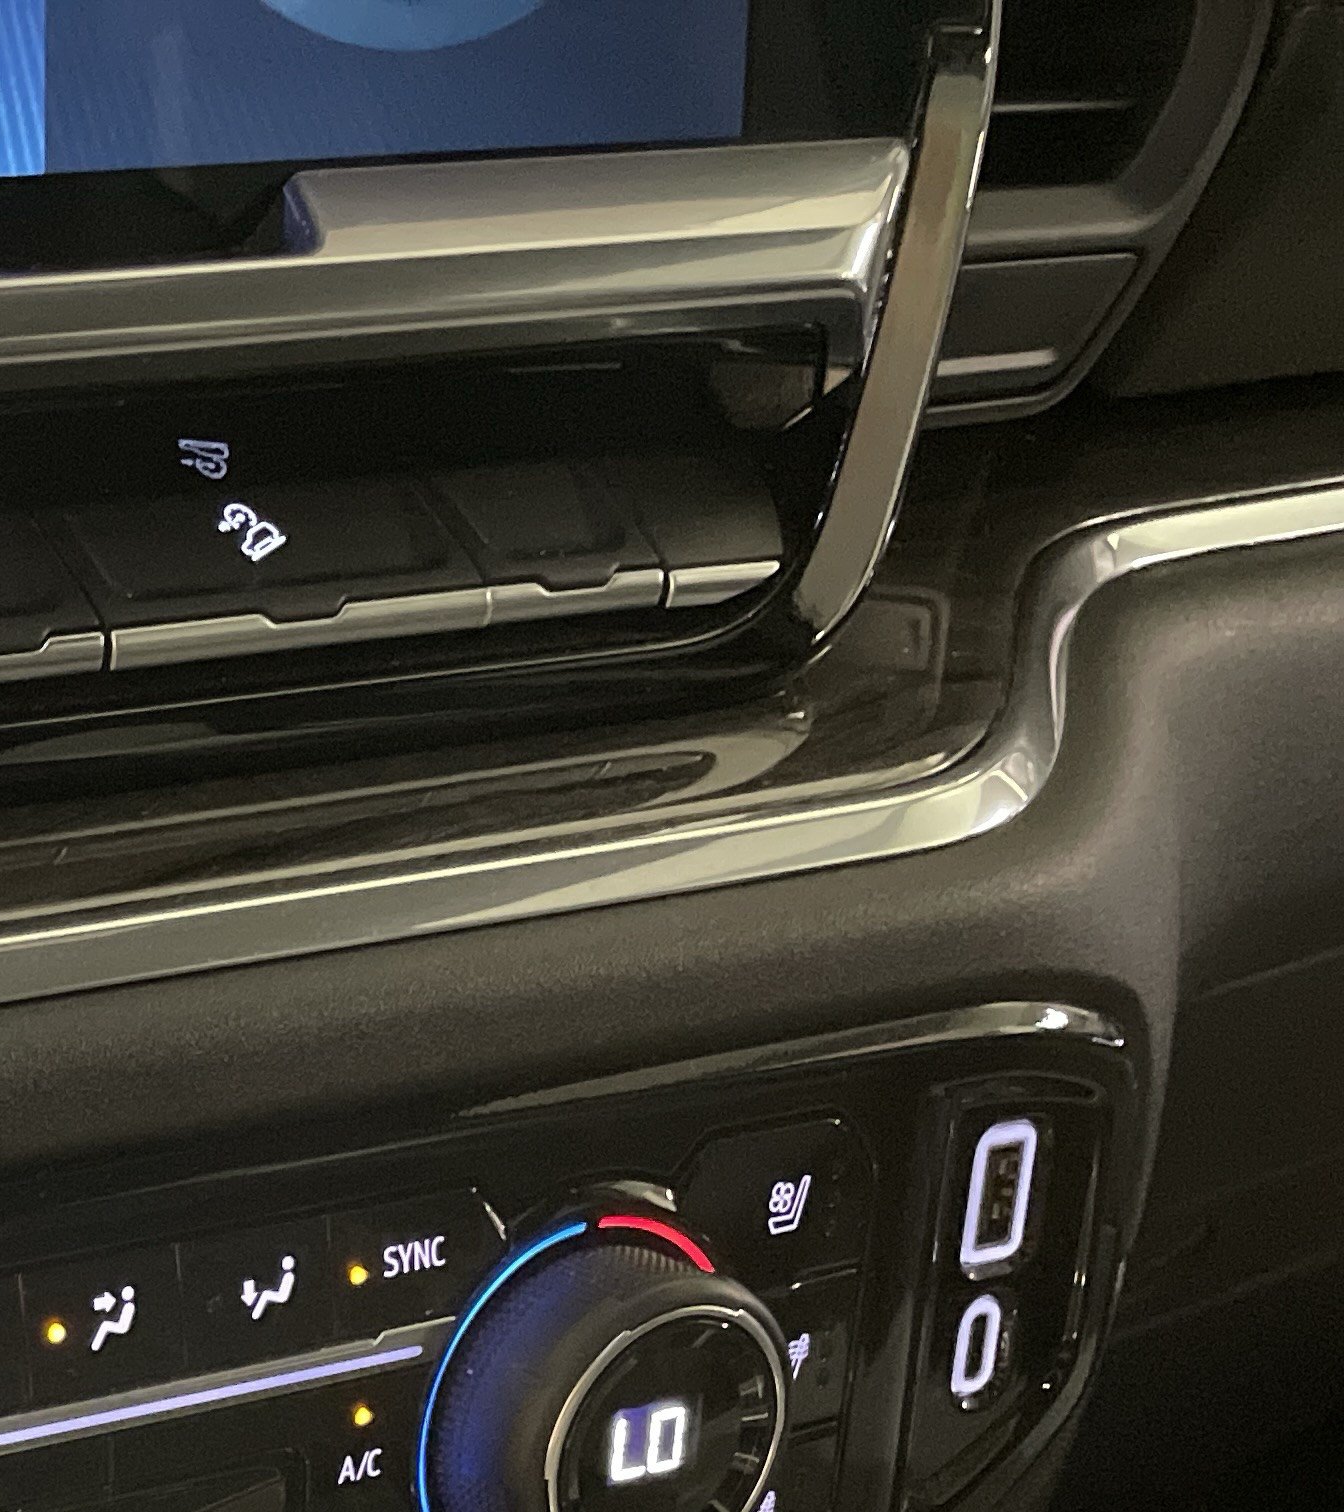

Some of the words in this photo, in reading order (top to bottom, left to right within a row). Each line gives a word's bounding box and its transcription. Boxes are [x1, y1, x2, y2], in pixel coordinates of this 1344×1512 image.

[382, 1235, 447, 1279] SYNC
[608, 1401, 690, 1485] LO
[337, 1448, 383, 1486] A/C
